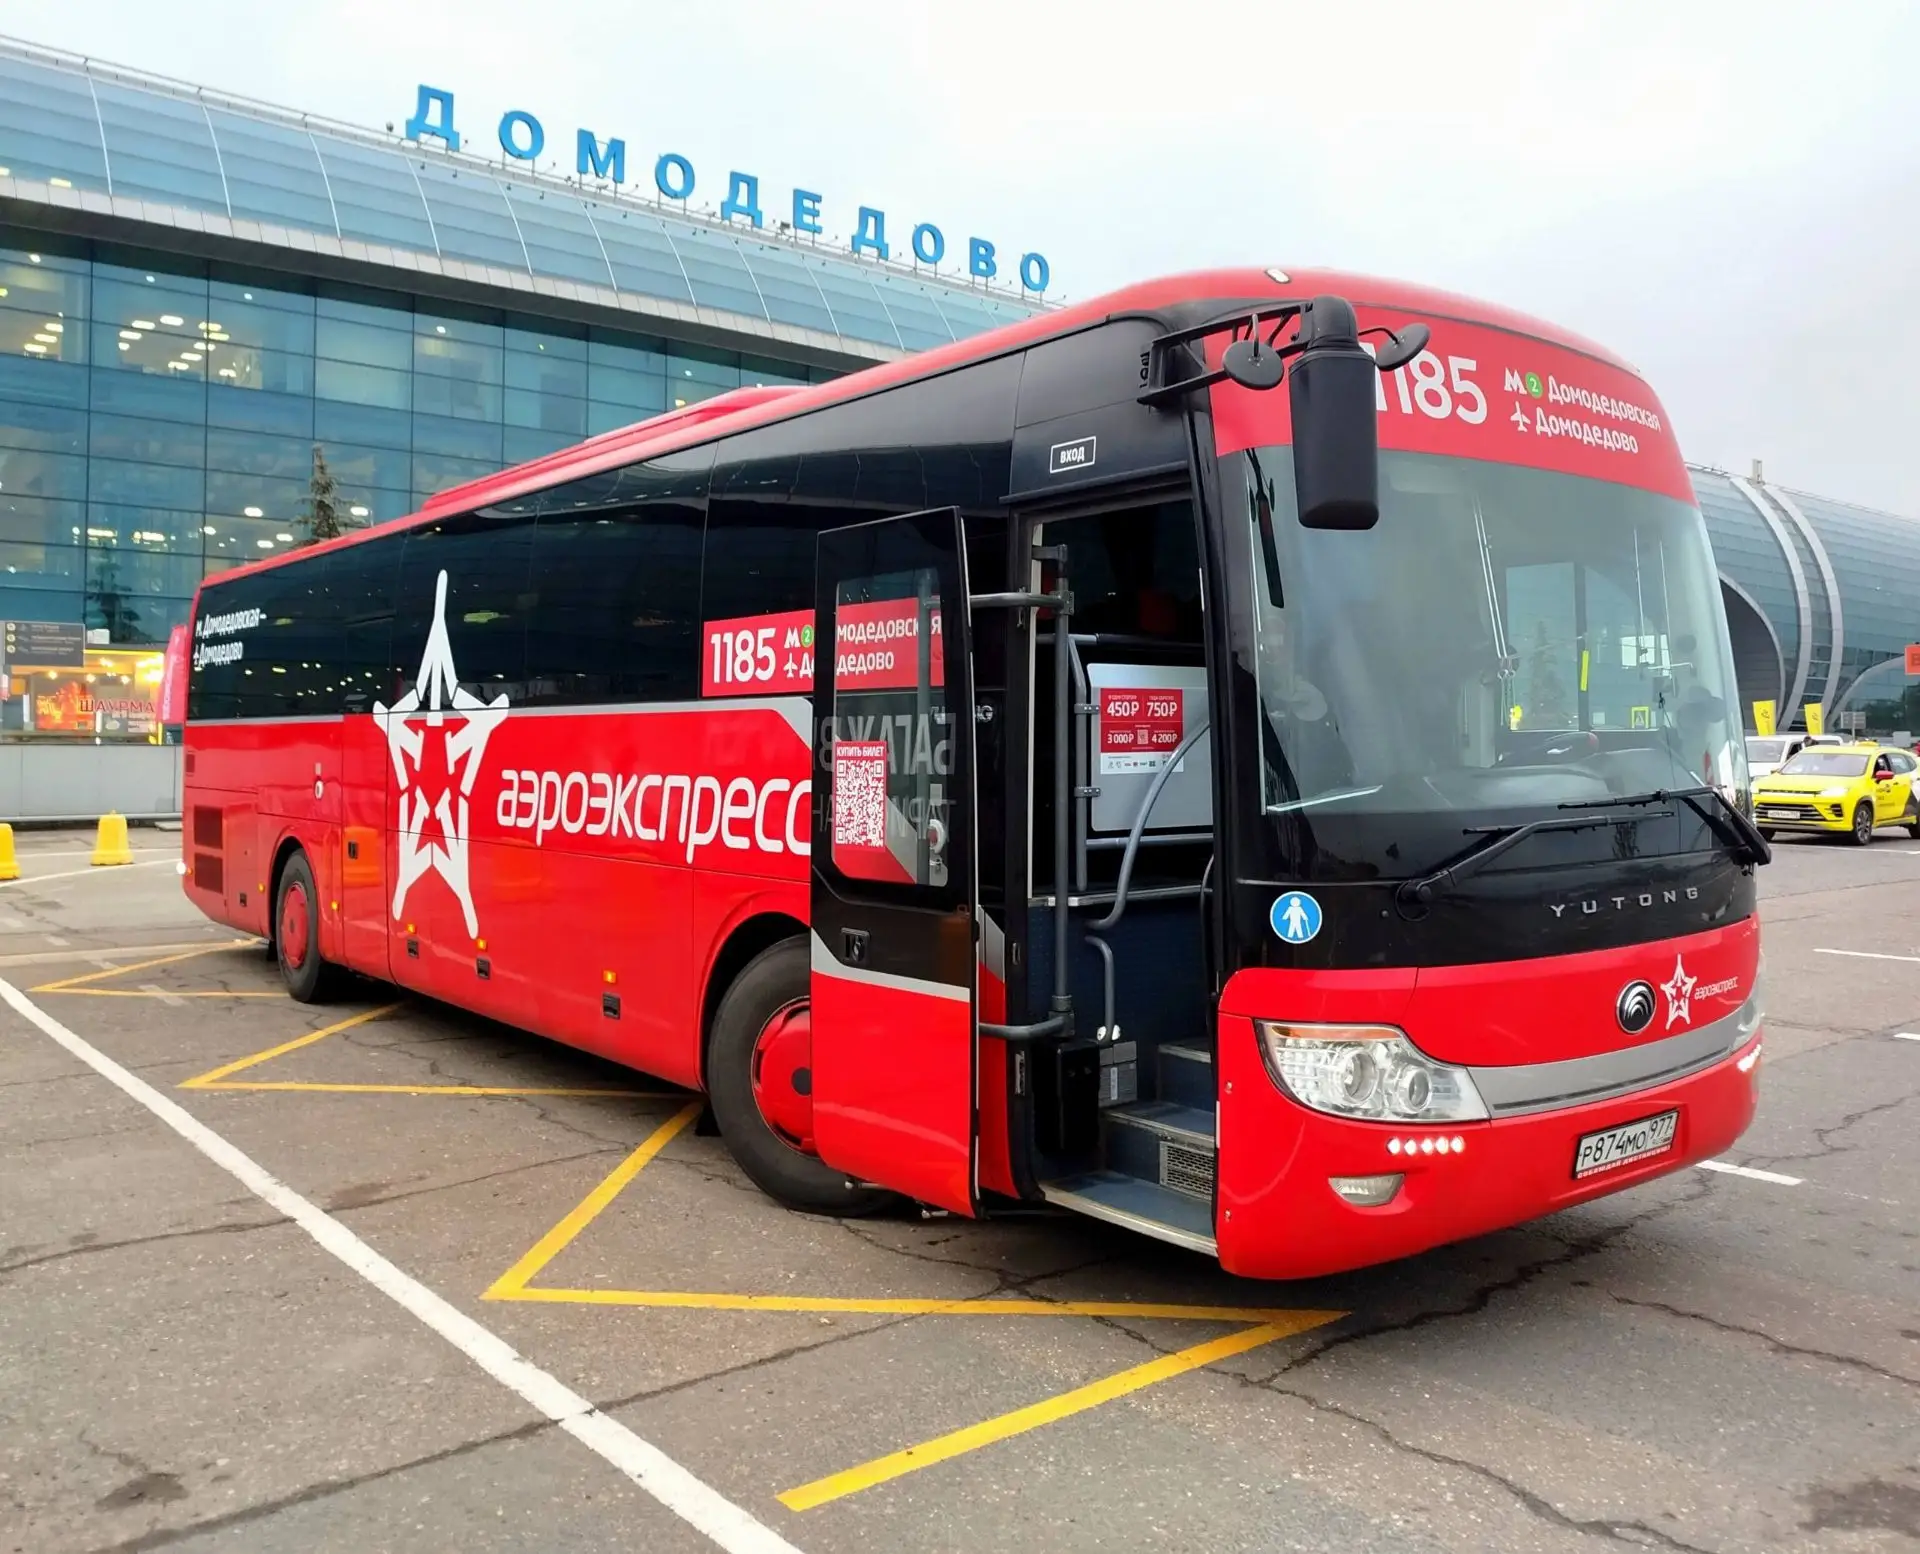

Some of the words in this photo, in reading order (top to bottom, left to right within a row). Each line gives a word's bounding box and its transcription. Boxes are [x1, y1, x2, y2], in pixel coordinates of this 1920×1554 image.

[406, 84, 1050, 292] ДОМОДЕДОВО
[1548, 375, 1661, 432] Домодедовская
[1536, 407, 1638, 454] Домодедово
[1060, 446, 1085, 464] ВХОД
[711, 628, 776, 683] 1185
[836, 746, 862, 757] КУПИТЬ
[862, 746, 884, 757] БИЛЕТ
[497, 769, 812, 864] аэроэкспресс
[1550, 887, 1698, 917] YUTONG
[1650, 1115, 1674, 1139] 977
